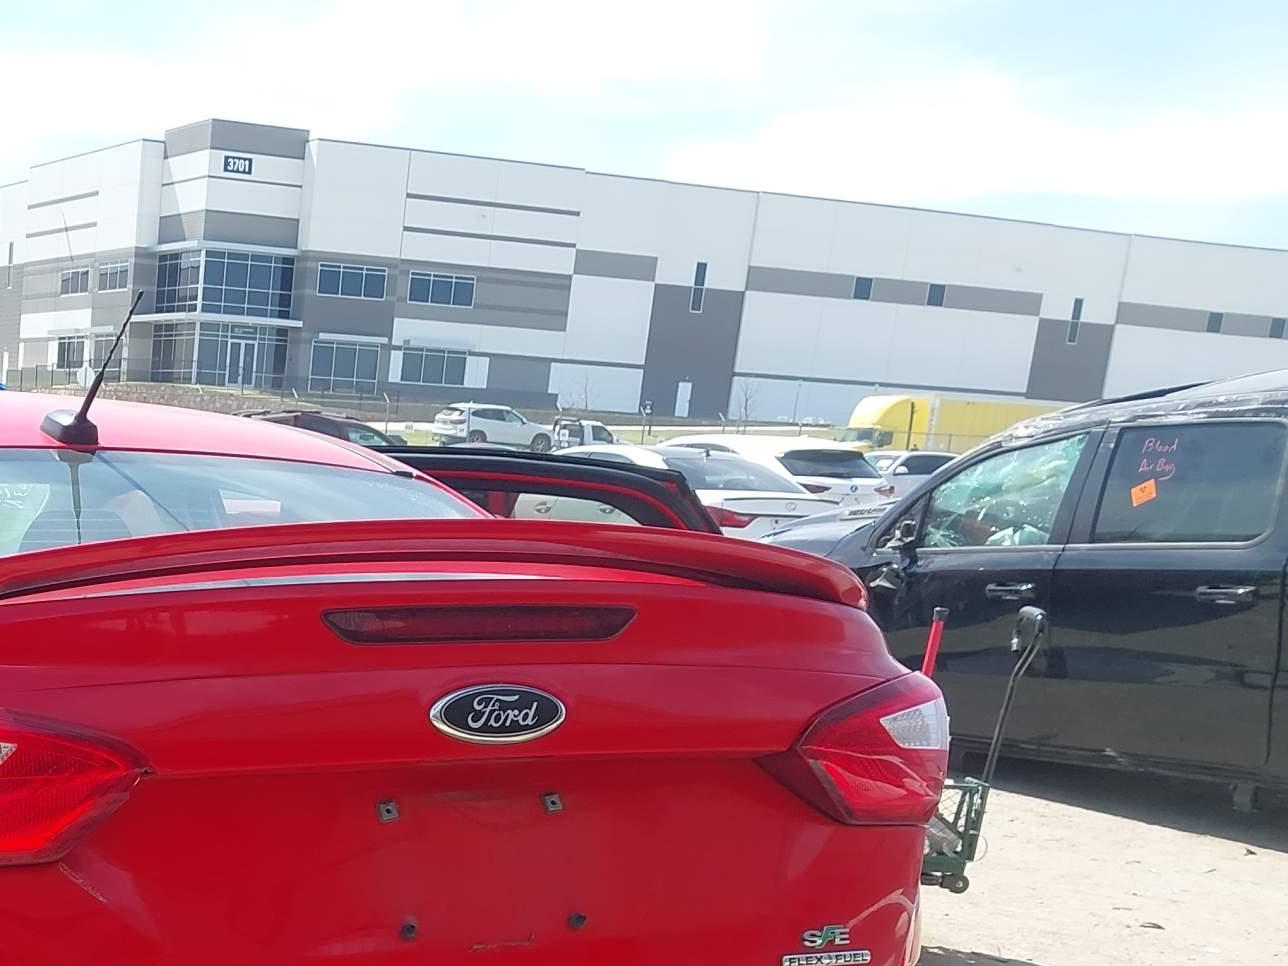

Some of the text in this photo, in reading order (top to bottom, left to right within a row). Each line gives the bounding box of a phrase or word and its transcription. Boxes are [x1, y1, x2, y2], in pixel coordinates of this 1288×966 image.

[227, 157, 250, 172] 3701
[1142, 437, 1179, 454] Blood
[467, 694, 538, 729] Ford
[787, 952, 870, 966] FLEX FUEL
